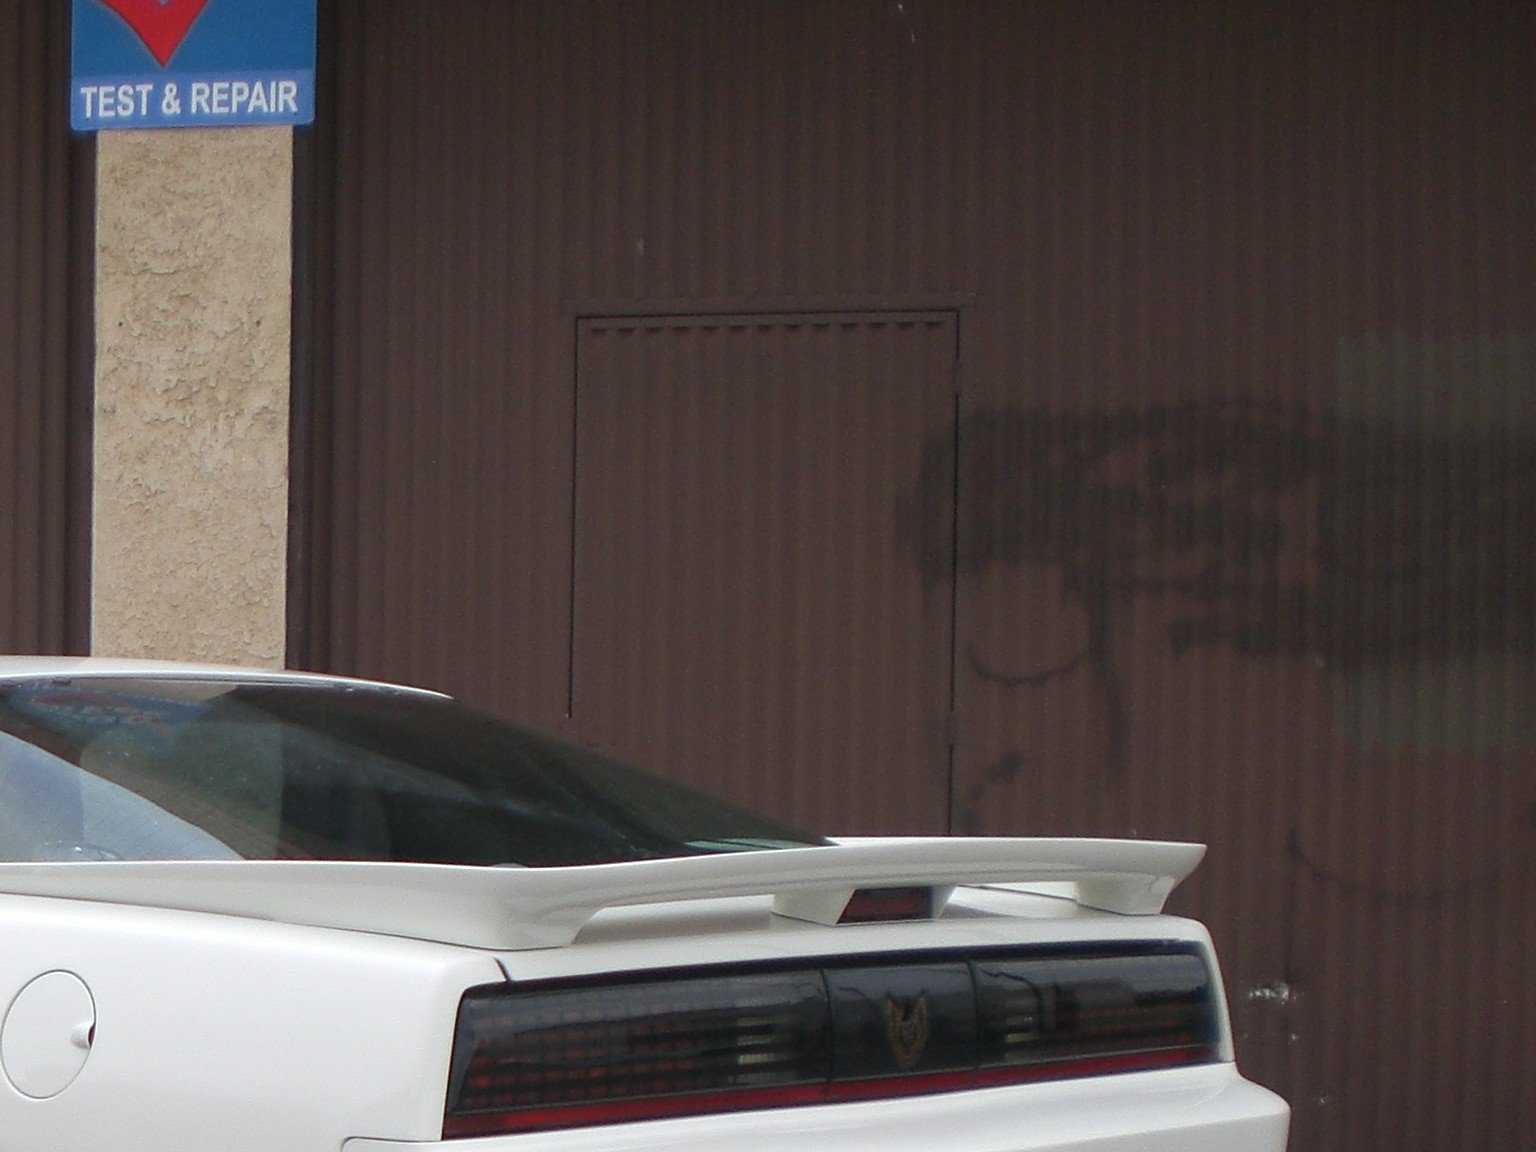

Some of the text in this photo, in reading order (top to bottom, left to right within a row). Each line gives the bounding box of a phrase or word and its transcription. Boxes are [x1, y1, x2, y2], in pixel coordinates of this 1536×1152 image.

[80, 80, 298, 118] TEST & REPAIR
